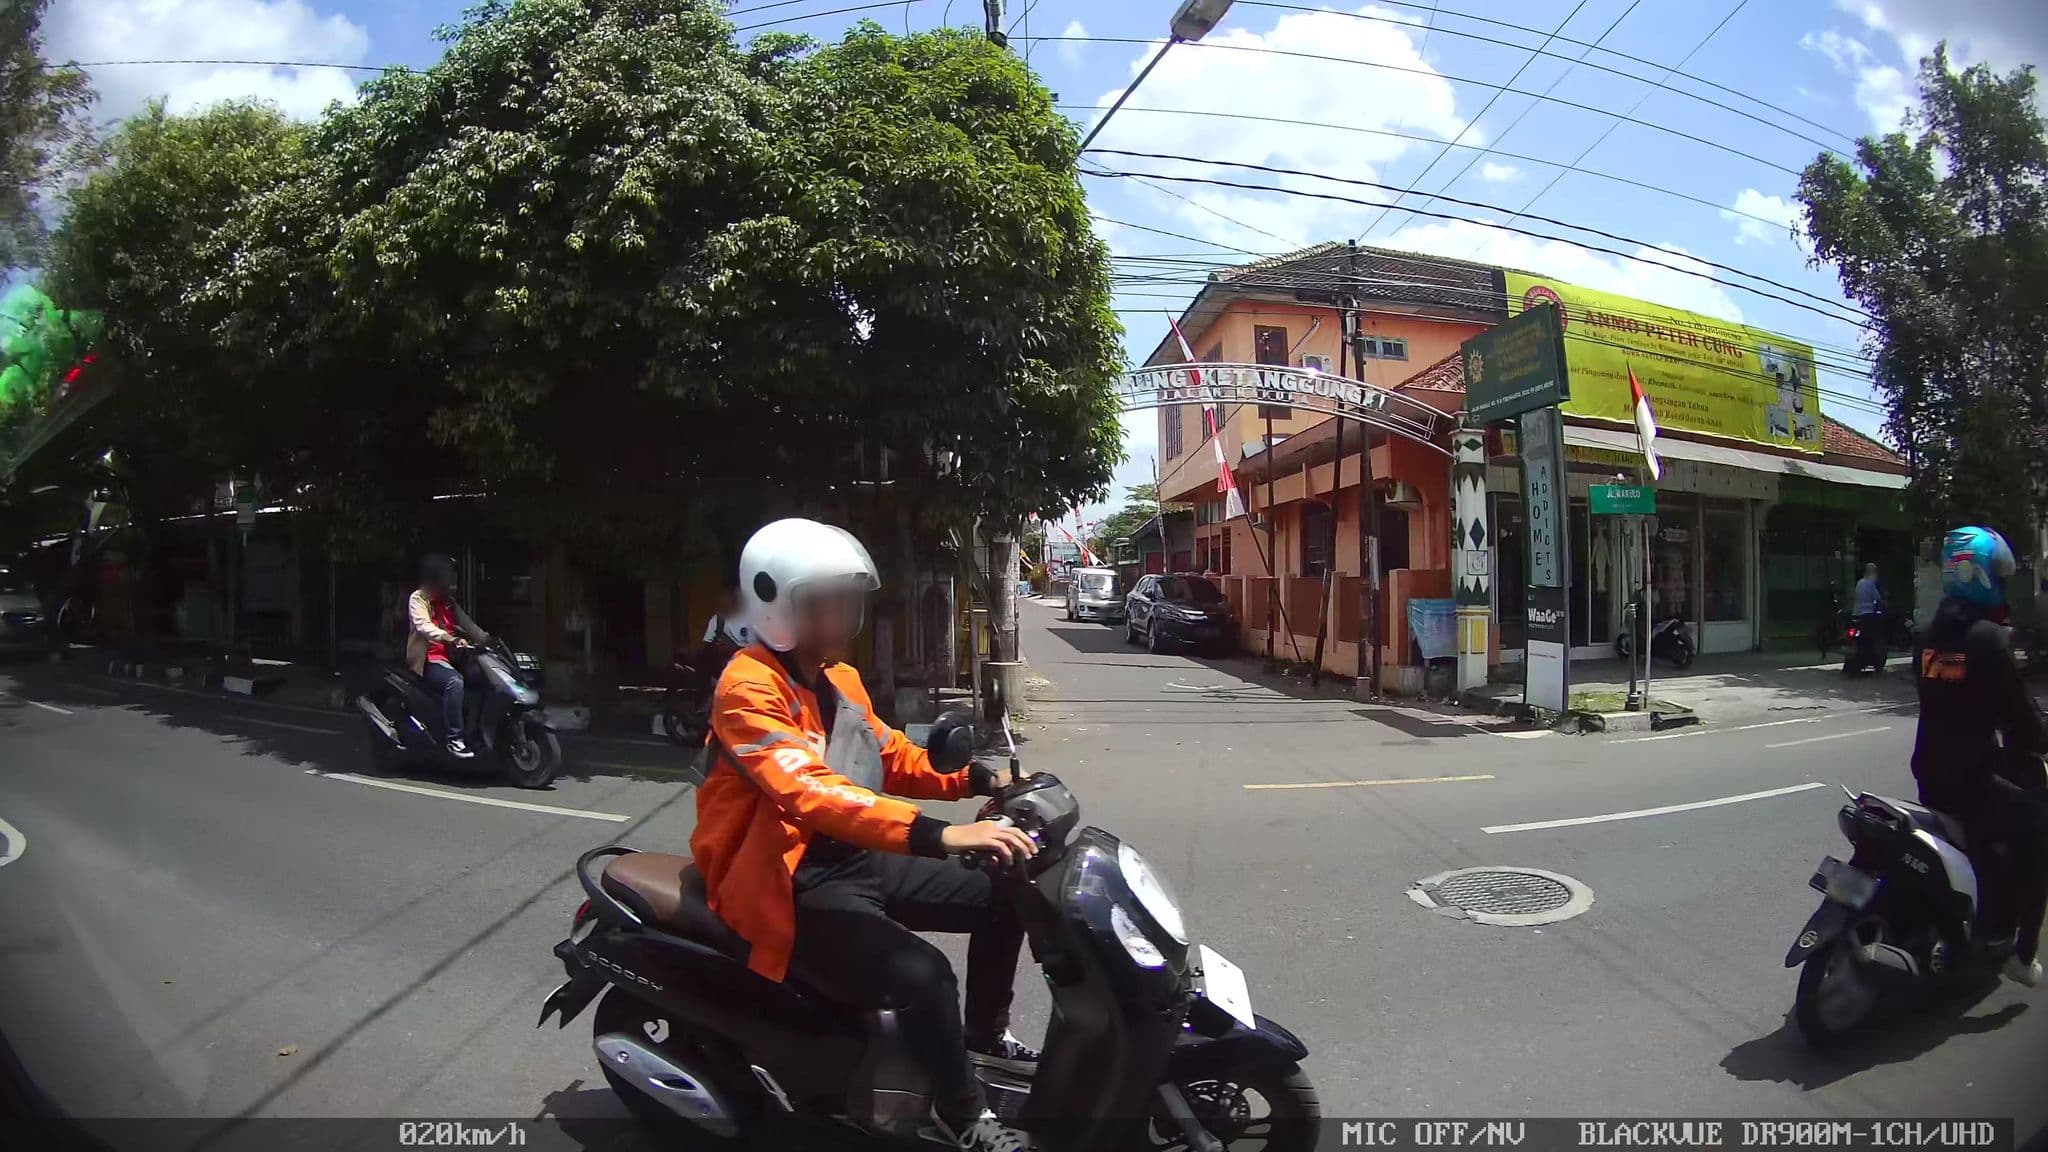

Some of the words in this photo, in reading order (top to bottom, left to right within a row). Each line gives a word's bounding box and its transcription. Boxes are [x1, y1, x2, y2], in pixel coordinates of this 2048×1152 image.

[1645, 322, 1699, 348] PETER
[1703, 334, 1743, 358] CUNG
[1532, 481, 1542, 566] HOME
[1541, 466, 1552, 581] ADDICTS
